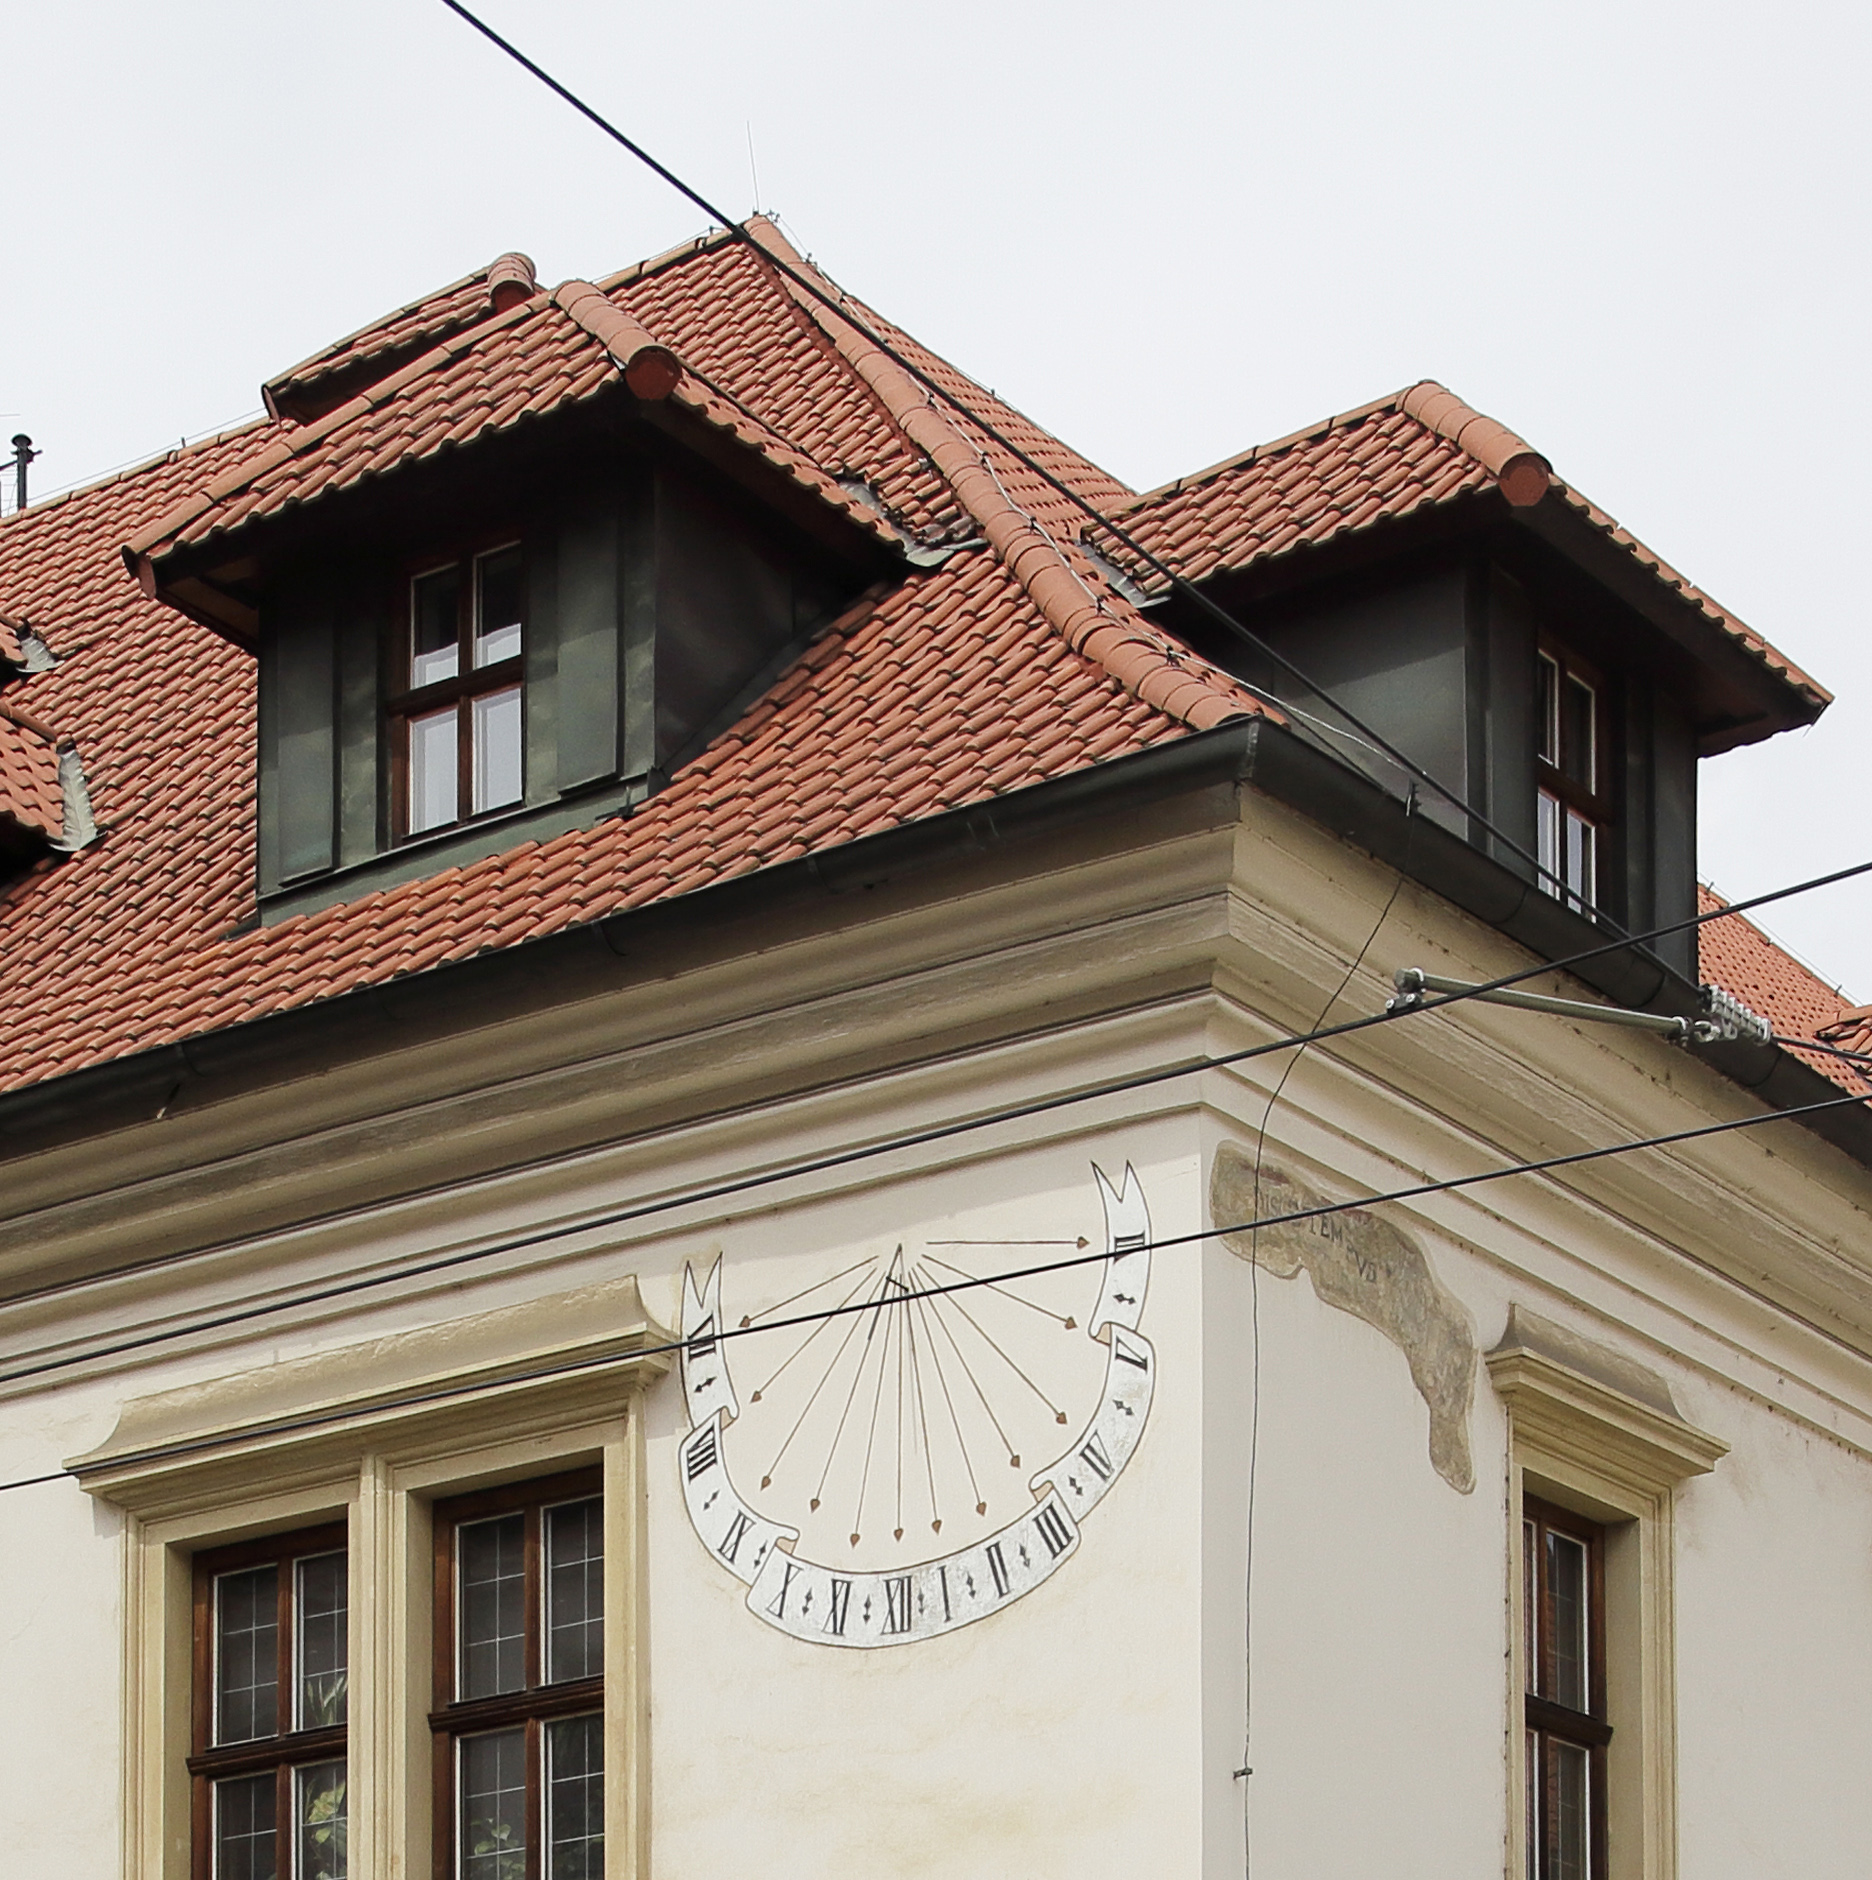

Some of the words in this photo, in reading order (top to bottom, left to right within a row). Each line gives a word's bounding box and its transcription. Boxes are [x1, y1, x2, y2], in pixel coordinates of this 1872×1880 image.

[686, 1424, 718, 1482] VIII
[717, 1511, 756, 1563] IX
[765, 1562, 804, 1619] X
[822, 1578, 852, 1636] XI
[880, 1576, 913, 1635] XII
[938, 1565, 952, 1622] I
[986, 1541, 1011, 1599] II
[1032, 1502, 1075, 1559] III
[1079, 1430, 1115, 1482] IV
[1114, 1335, 1148, 1372] V
